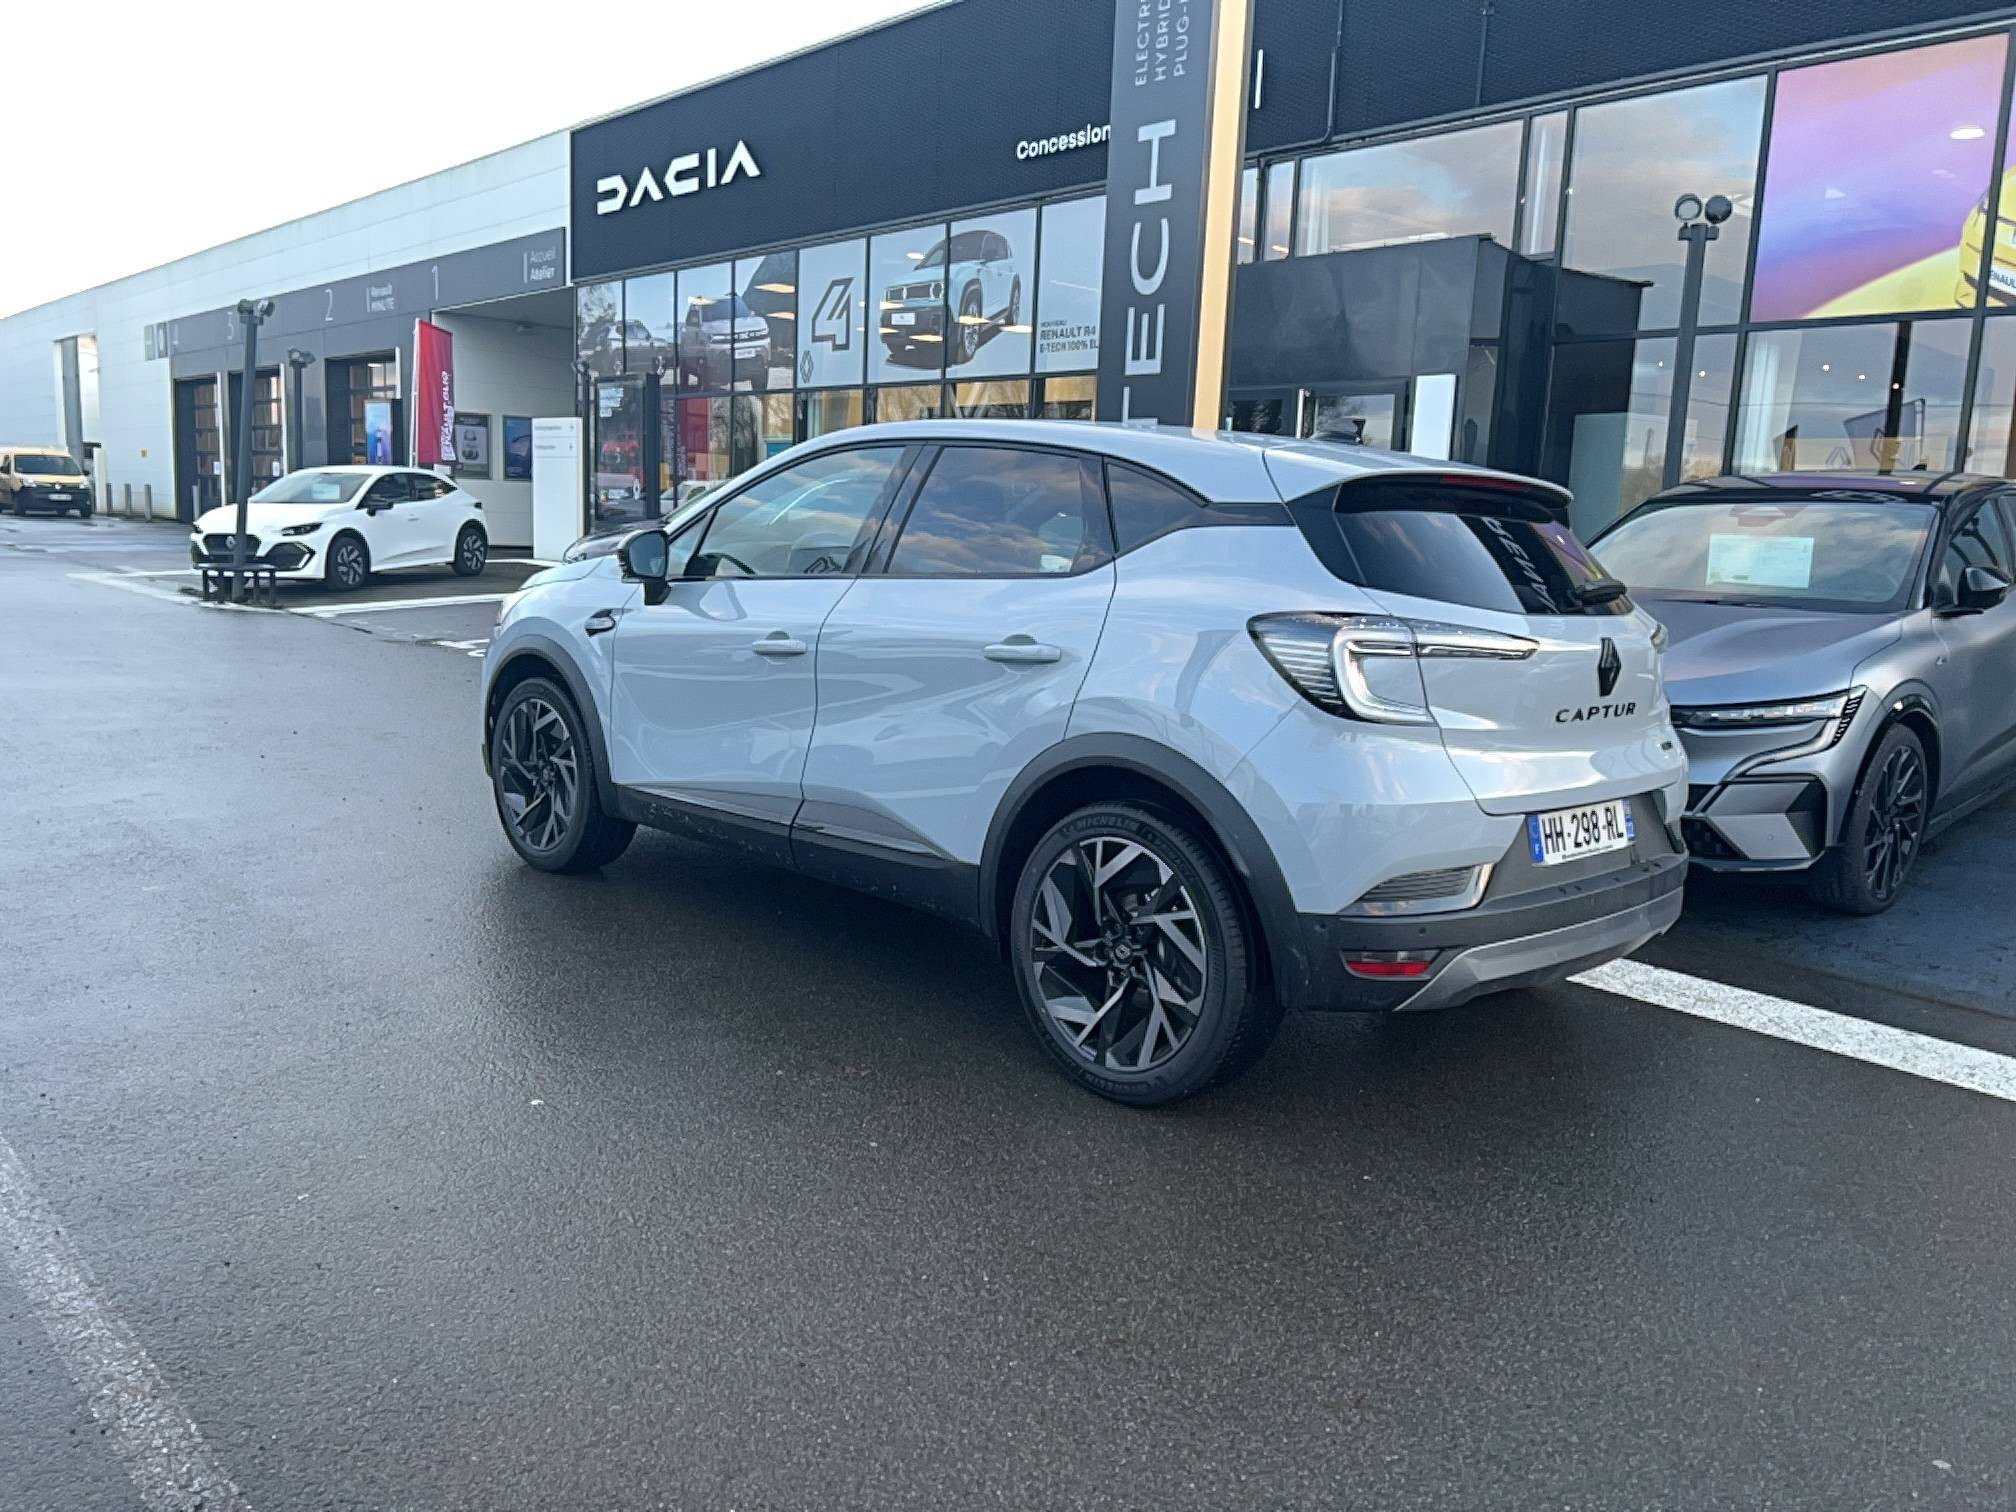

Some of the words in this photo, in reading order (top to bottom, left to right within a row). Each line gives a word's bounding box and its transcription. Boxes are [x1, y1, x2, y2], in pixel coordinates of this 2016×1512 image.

[1135, 0, 1152, 86] ELECTR
[1016, 123, 1111, 160] Concession
[596, 139, 762, 215] DACIA
[432, 264, 439, 300] 1
[325, 288, 334, 321] 2
[1040, 326, 1083, 341] RENAULT
[1555, 702, 1637, 723] CAPTUR
[1541, 805, 1625, 855] HH-298-RL
